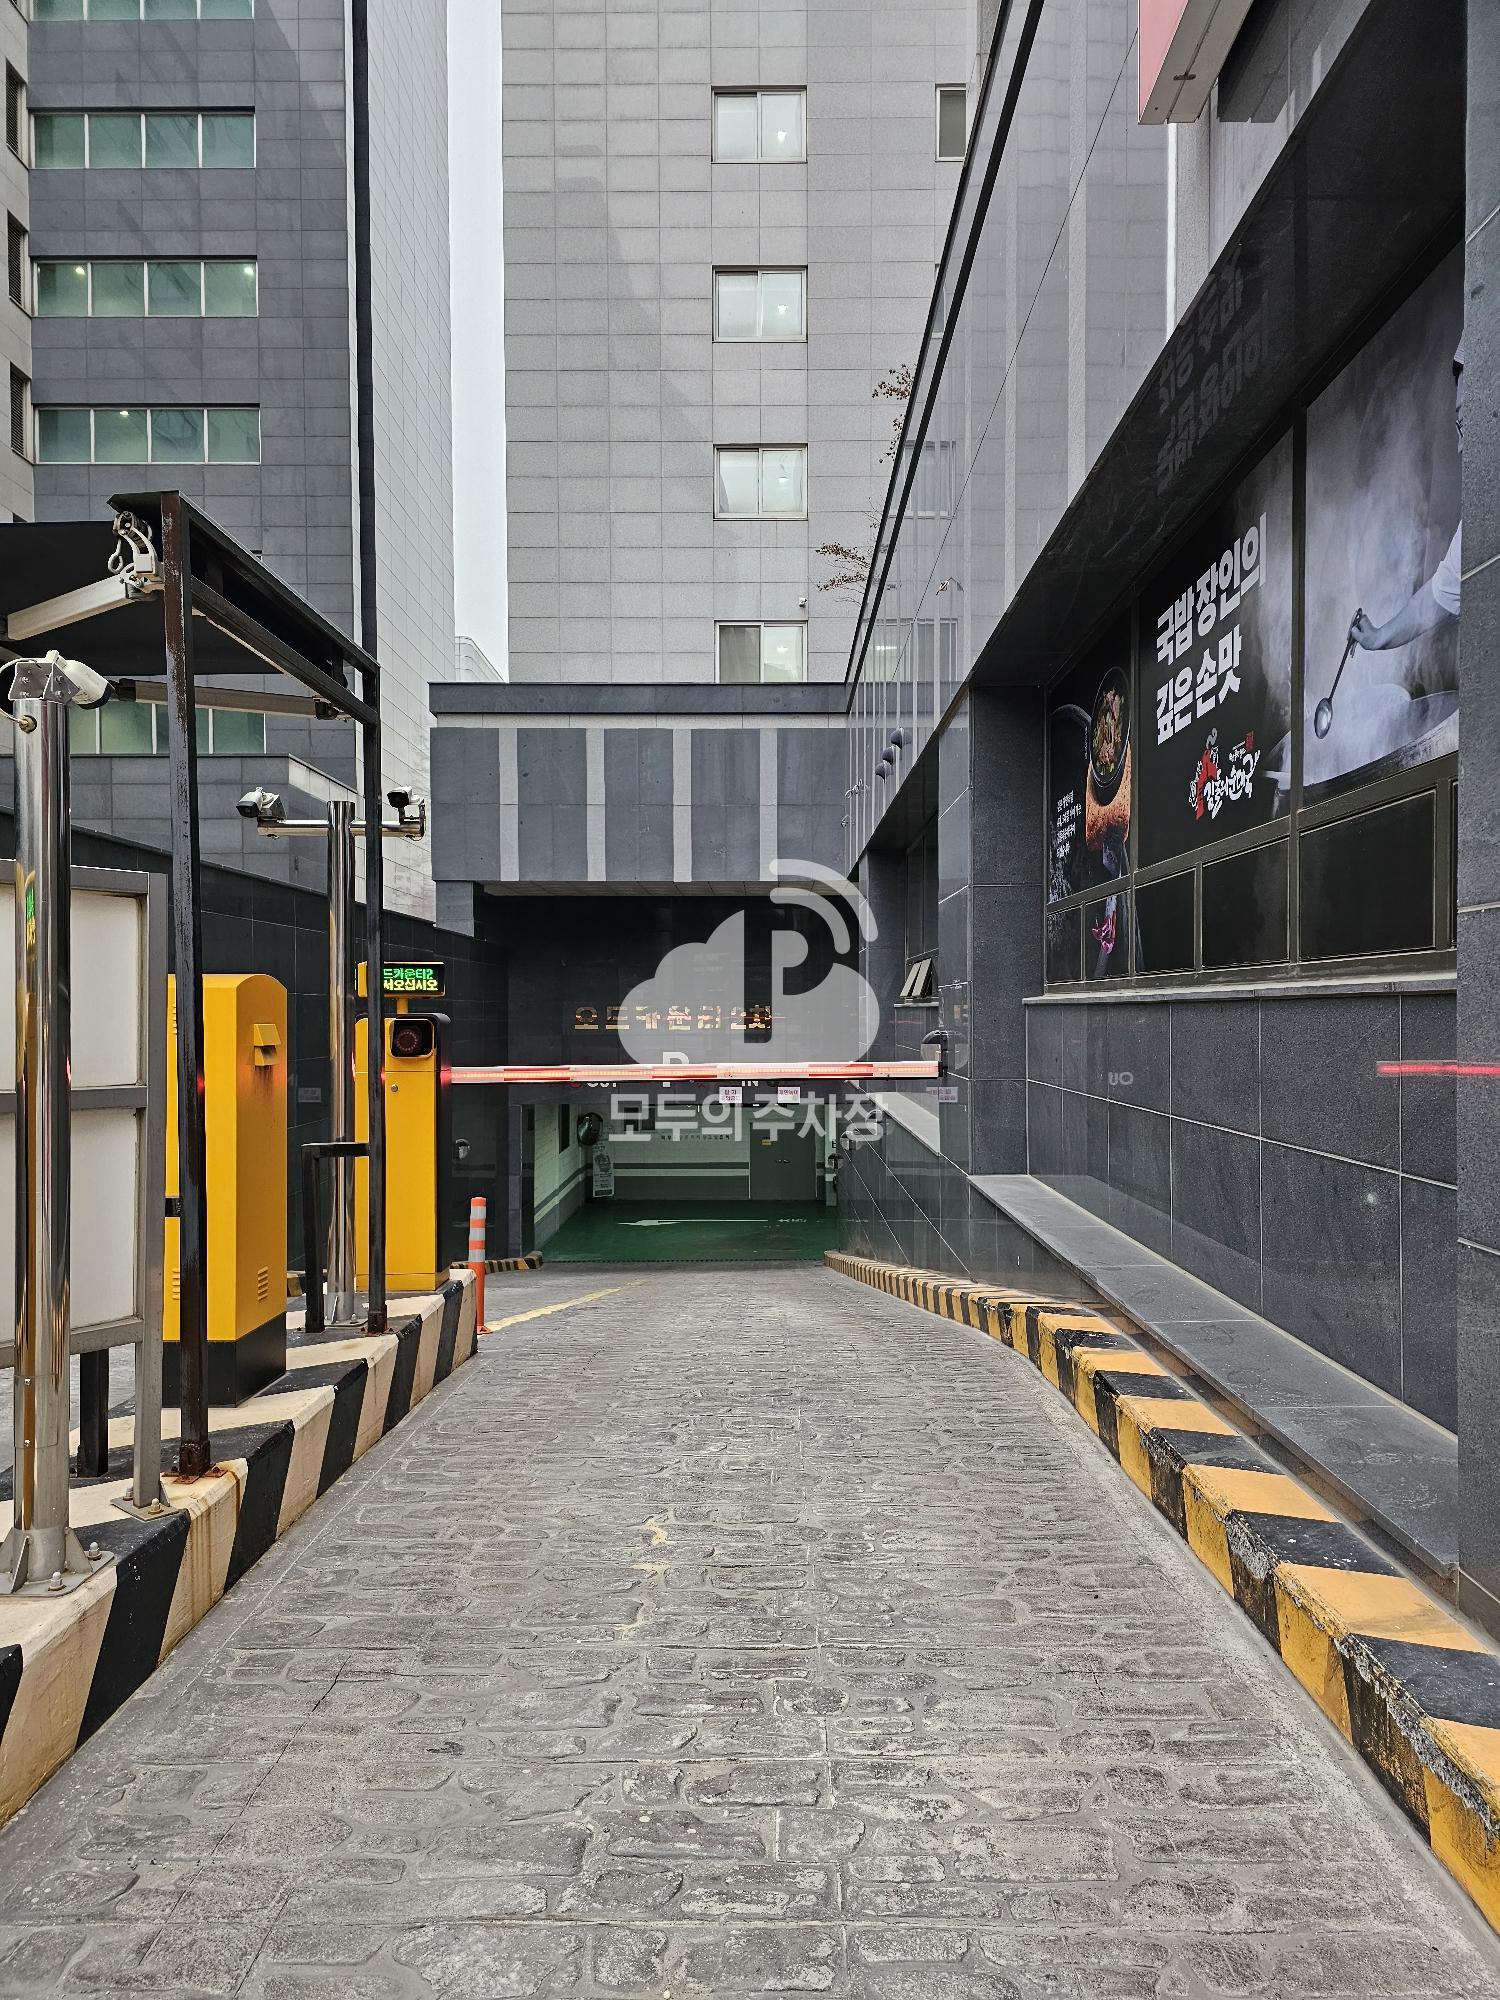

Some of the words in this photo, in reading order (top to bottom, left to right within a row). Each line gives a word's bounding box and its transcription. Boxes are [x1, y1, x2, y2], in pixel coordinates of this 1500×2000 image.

[1157, 585, 1194, 665] 국밥
[1196, 511, 1267, 637] 장인의
[1156, 667, 1193, 745] 깊은
[1196, 624, 1241, 719] 손맛
[383, 968, 434, 979] 드카운티2
[383, 979, 439, 991] 서오십시오
